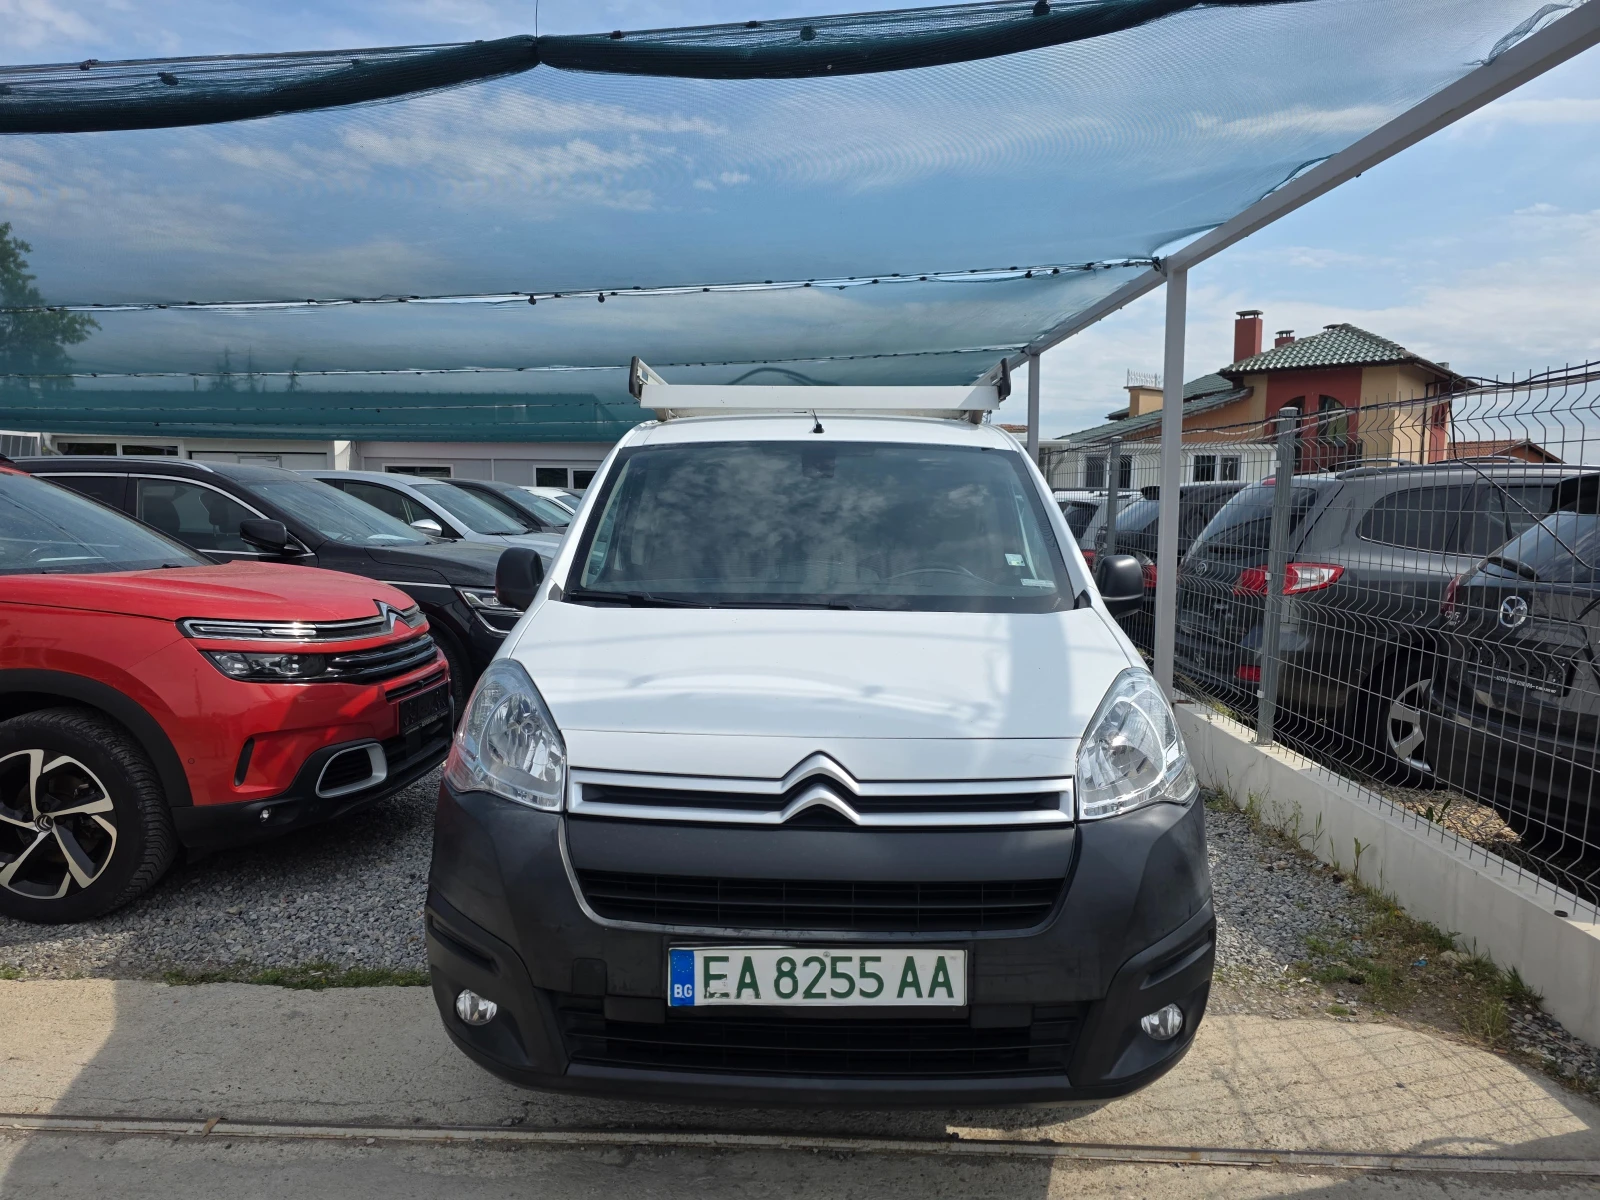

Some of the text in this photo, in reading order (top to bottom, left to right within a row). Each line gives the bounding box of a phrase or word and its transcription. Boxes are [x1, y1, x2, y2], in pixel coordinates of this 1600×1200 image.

[674, 984, 692, 998] BG
[703, 956, 954, 999] EA 8255 AA
